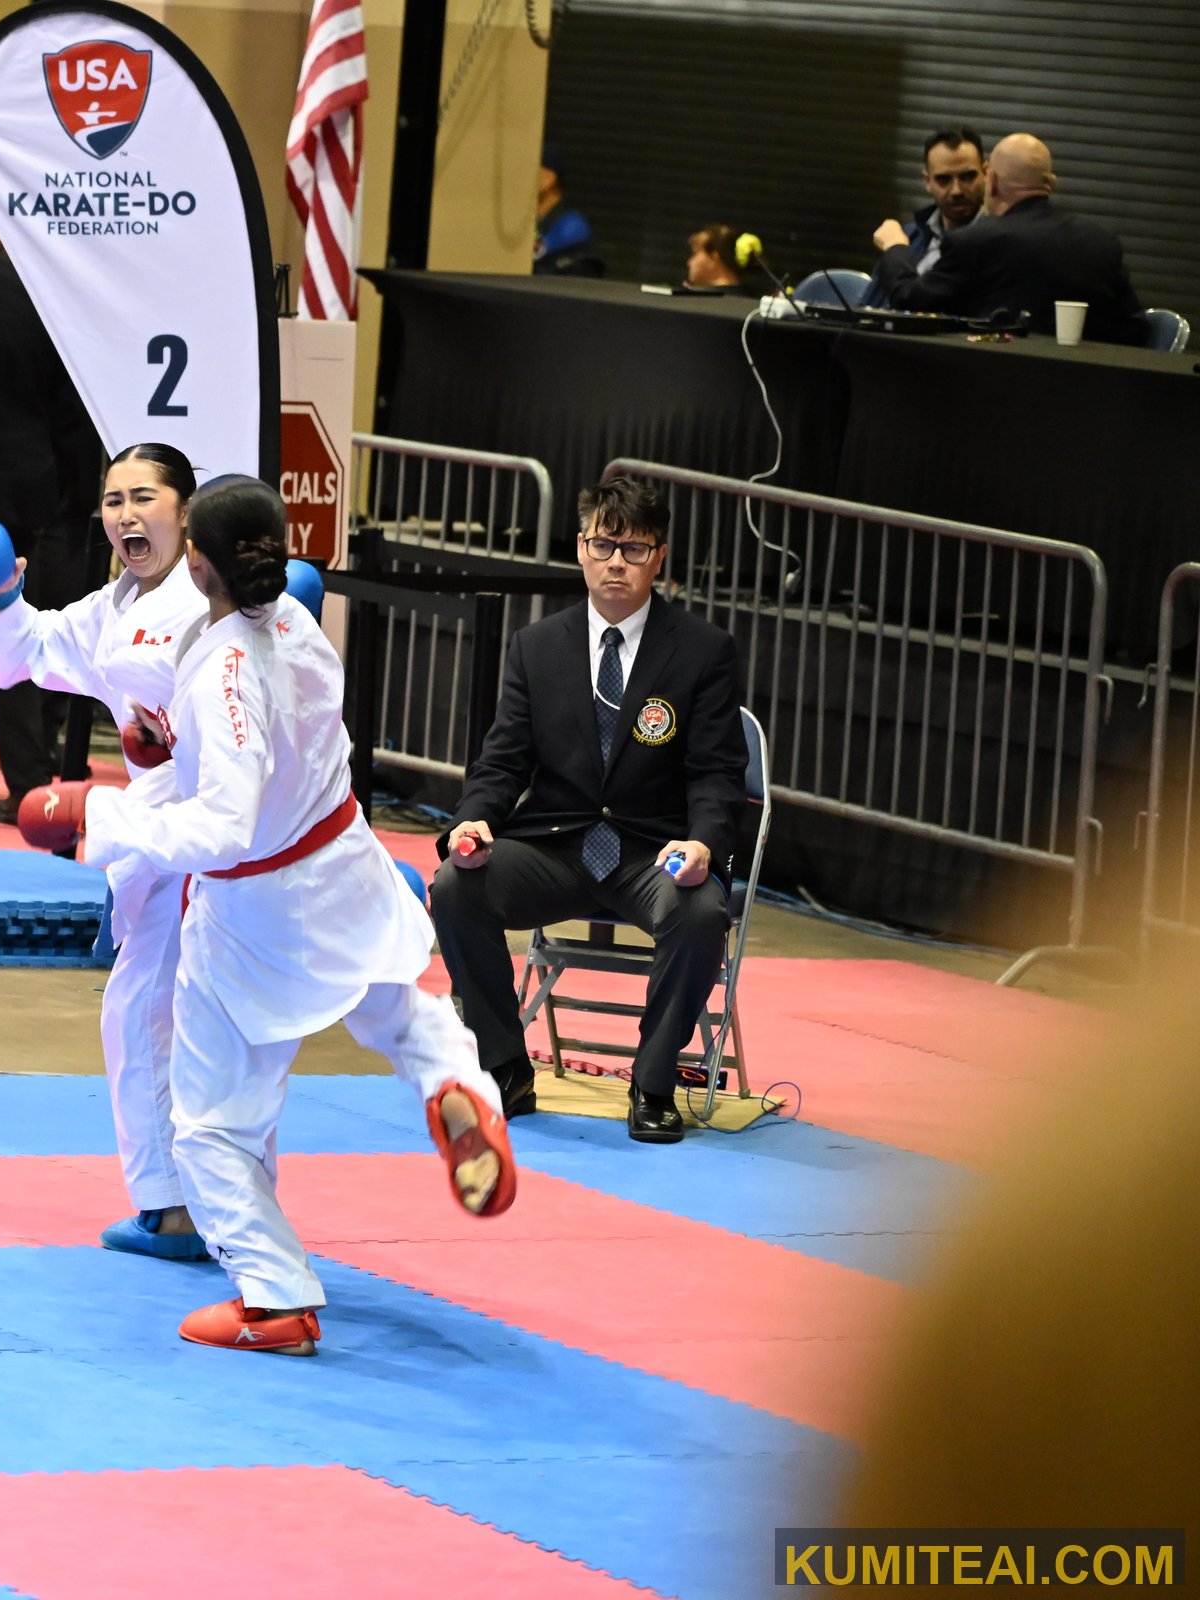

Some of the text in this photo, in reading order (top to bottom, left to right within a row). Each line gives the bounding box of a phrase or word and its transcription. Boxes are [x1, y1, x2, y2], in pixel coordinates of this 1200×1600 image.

[58, 58, 138, 92] USA
[45, 171, 157, 188] NATIONAL
[8, 191, 196, 217] KARATE-DO
[47, 221, 159, 236] FEDERATION
[146, 334, 188, 417] 2
[280, 471, 337, 505] CIALS
[222, 645, 247, 750] Arawaza
